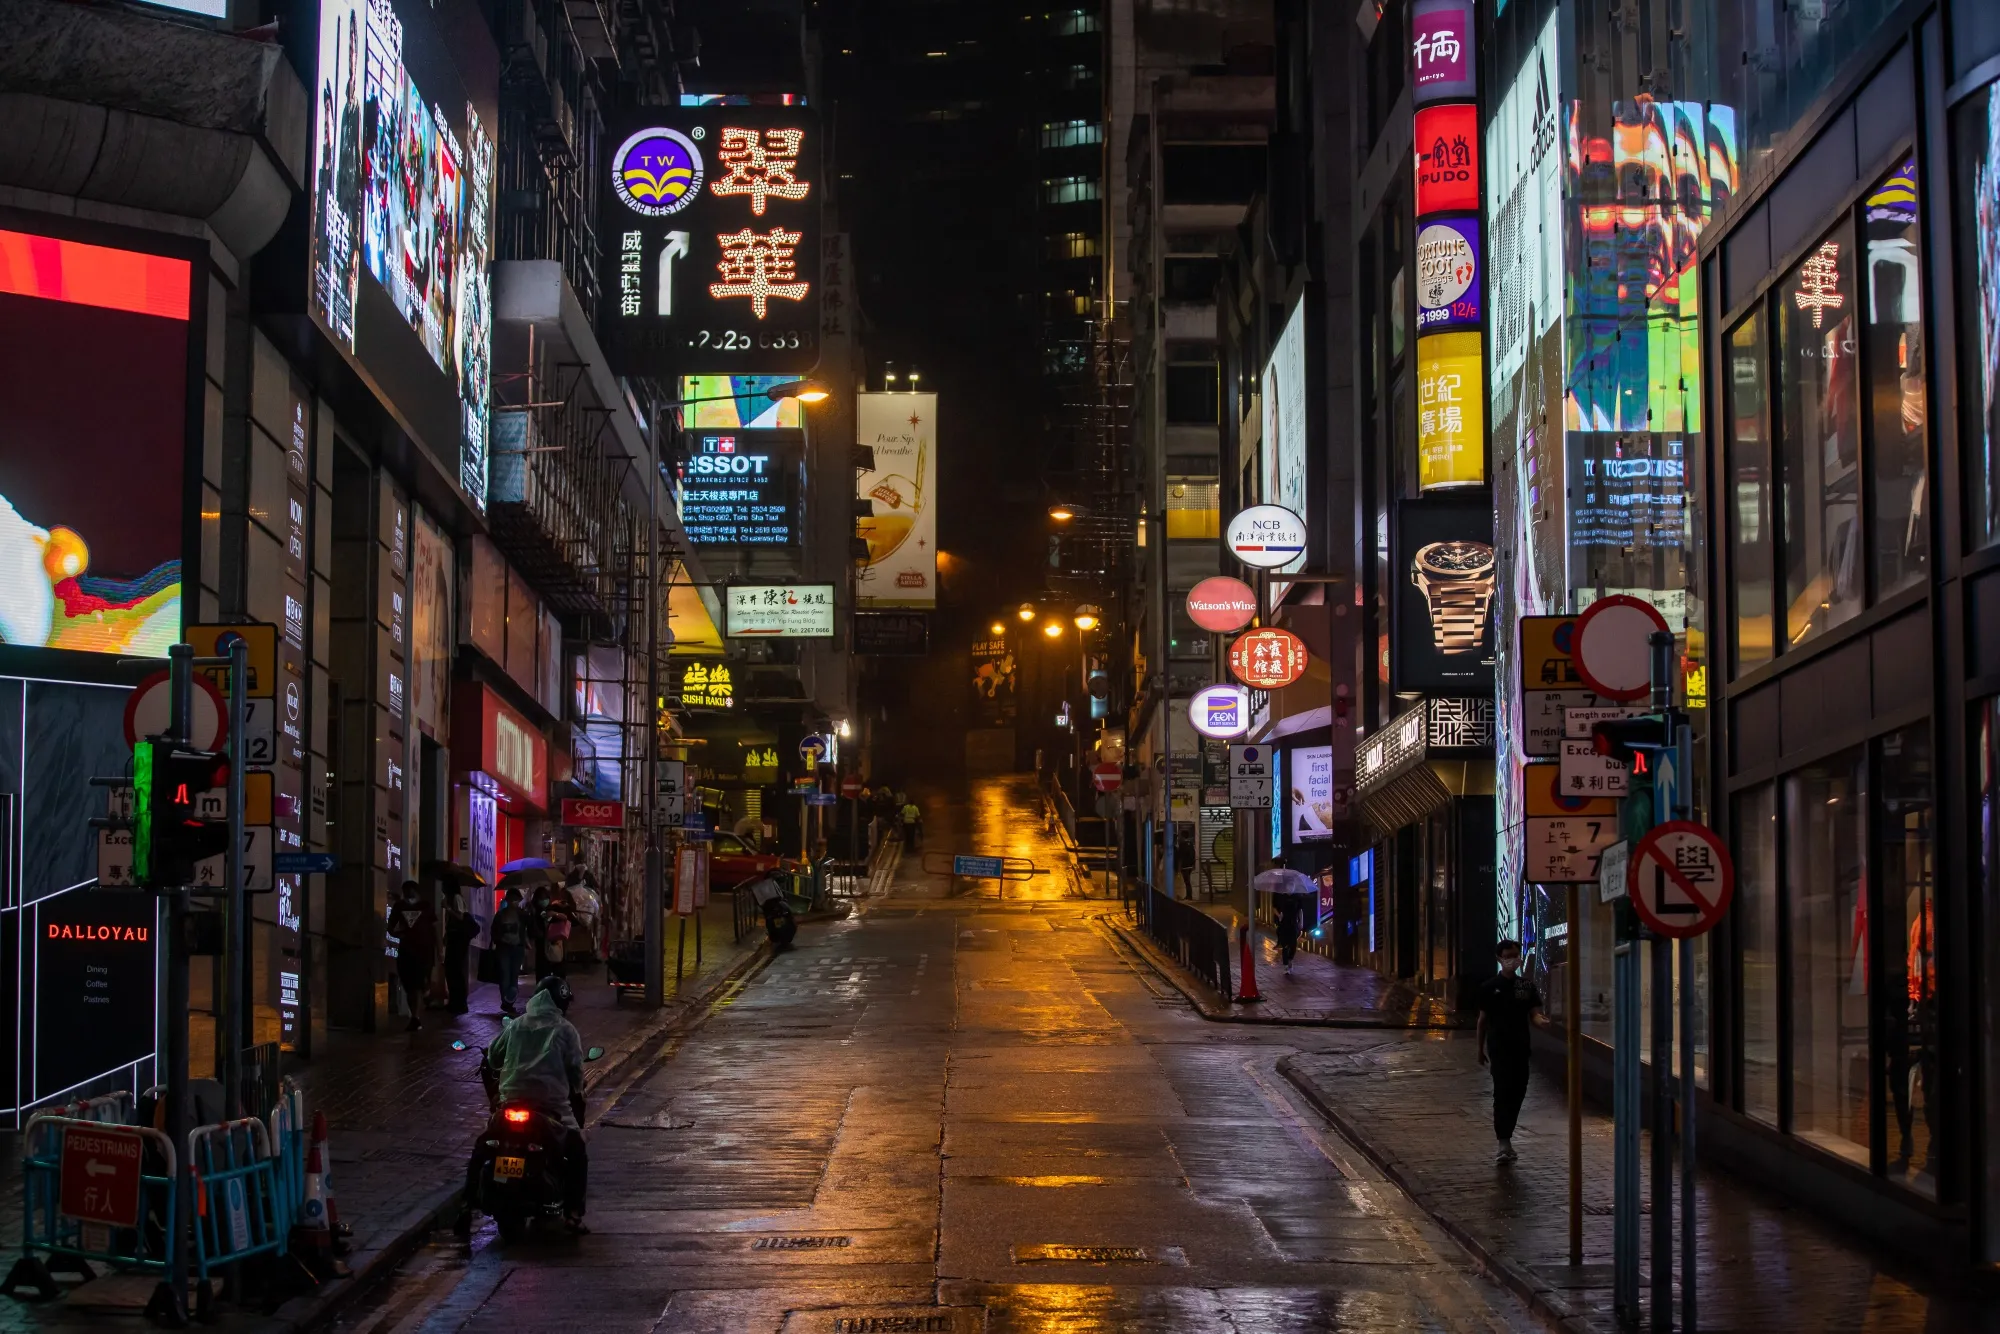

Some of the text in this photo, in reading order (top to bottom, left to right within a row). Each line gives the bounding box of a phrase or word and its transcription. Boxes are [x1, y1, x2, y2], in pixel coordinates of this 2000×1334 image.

[1530, 113, 1556, 176] adidas
[623, 192, 647, 214] WAH
[650, 168, 704, 216] RESTAURANT
[621, 230, 642, 316] 威靈頓街
[1421, 257, 1453, 279] FOOT
[1426, 308, 1450, 323] 1999
[1452, 302, 1476, 318] 12/F
[1421, 374, 1462, 406] 世紀
[1421, 406, 1463, 438] 廣場
[689, 455, 769, 474] ISSOT
[291, 498, 304, 526] NOW
[1253, 520, 1281, 530] NCB
[290, 535, 302, 560] OPEN
[705, 696, 726, 707] RAKU
[1545, 693, 1561, 701] am
[1569, 711, 1599, 720] Length
[1400, 714, 1419, 751] HUBLOT
[1567, 745, 1600, 757] Exce
[1366, 742, 1383, 774] HUBLOT
[1312, 762, 1328, 772] first
[1257, 780, 1264, 790] 7
[1309, 775, 1331, 785] facial
[1571, 775, 1628, 790] 專利巴
[1311, 787, 1328, 797] free
[667, 797, 676, 807] 7
[1257, 796, 1270, 806] 12
[668, 813, 681, 823] 12
[1550, 821, 1566, 829] am
[1545, 832, 1571, 844] 上午
[1587, 822, 1601, 842] 7
[106, 834, 133, 845] Exce
[1550, 855, 1566, 864] pm
[1587, 855, 1600, 877] 7
[1545, 866, 1572, 878] 下午
[48, 922, 149, 942] DALLOYAU
[86, 965, 108, 976] Dining
[86, 979, 108, 988] Coffee
[66, 1134, 138, 1159] PEDESTRIANS
[84, 1186, 114, 1215] 行人
